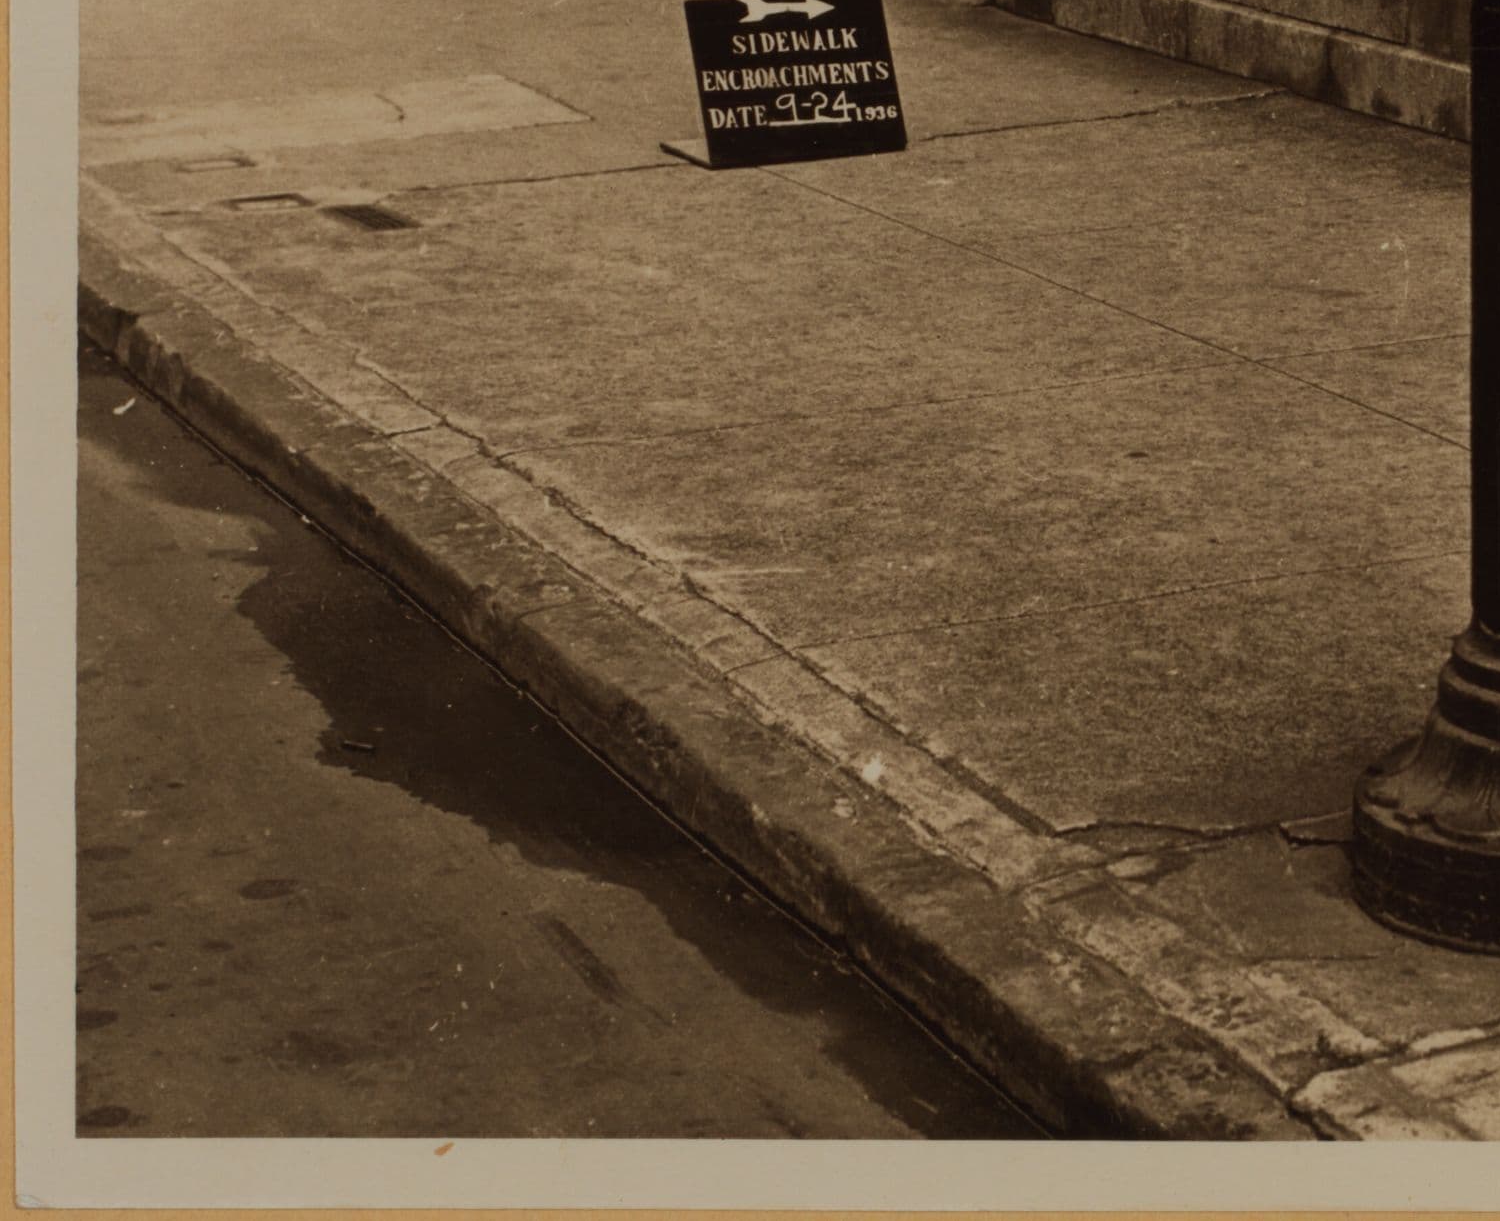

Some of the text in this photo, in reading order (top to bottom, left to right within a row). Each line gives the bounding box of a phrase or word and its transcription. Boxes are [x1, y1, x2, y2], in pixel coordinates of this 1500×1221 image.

[732, 28, 859, 55] SIDEWALK
[702, 61, 890, 92] ENCROACHMENTS
[708, 105, 770, 129] DATE
[775, 90, 857, 124] 9-24
